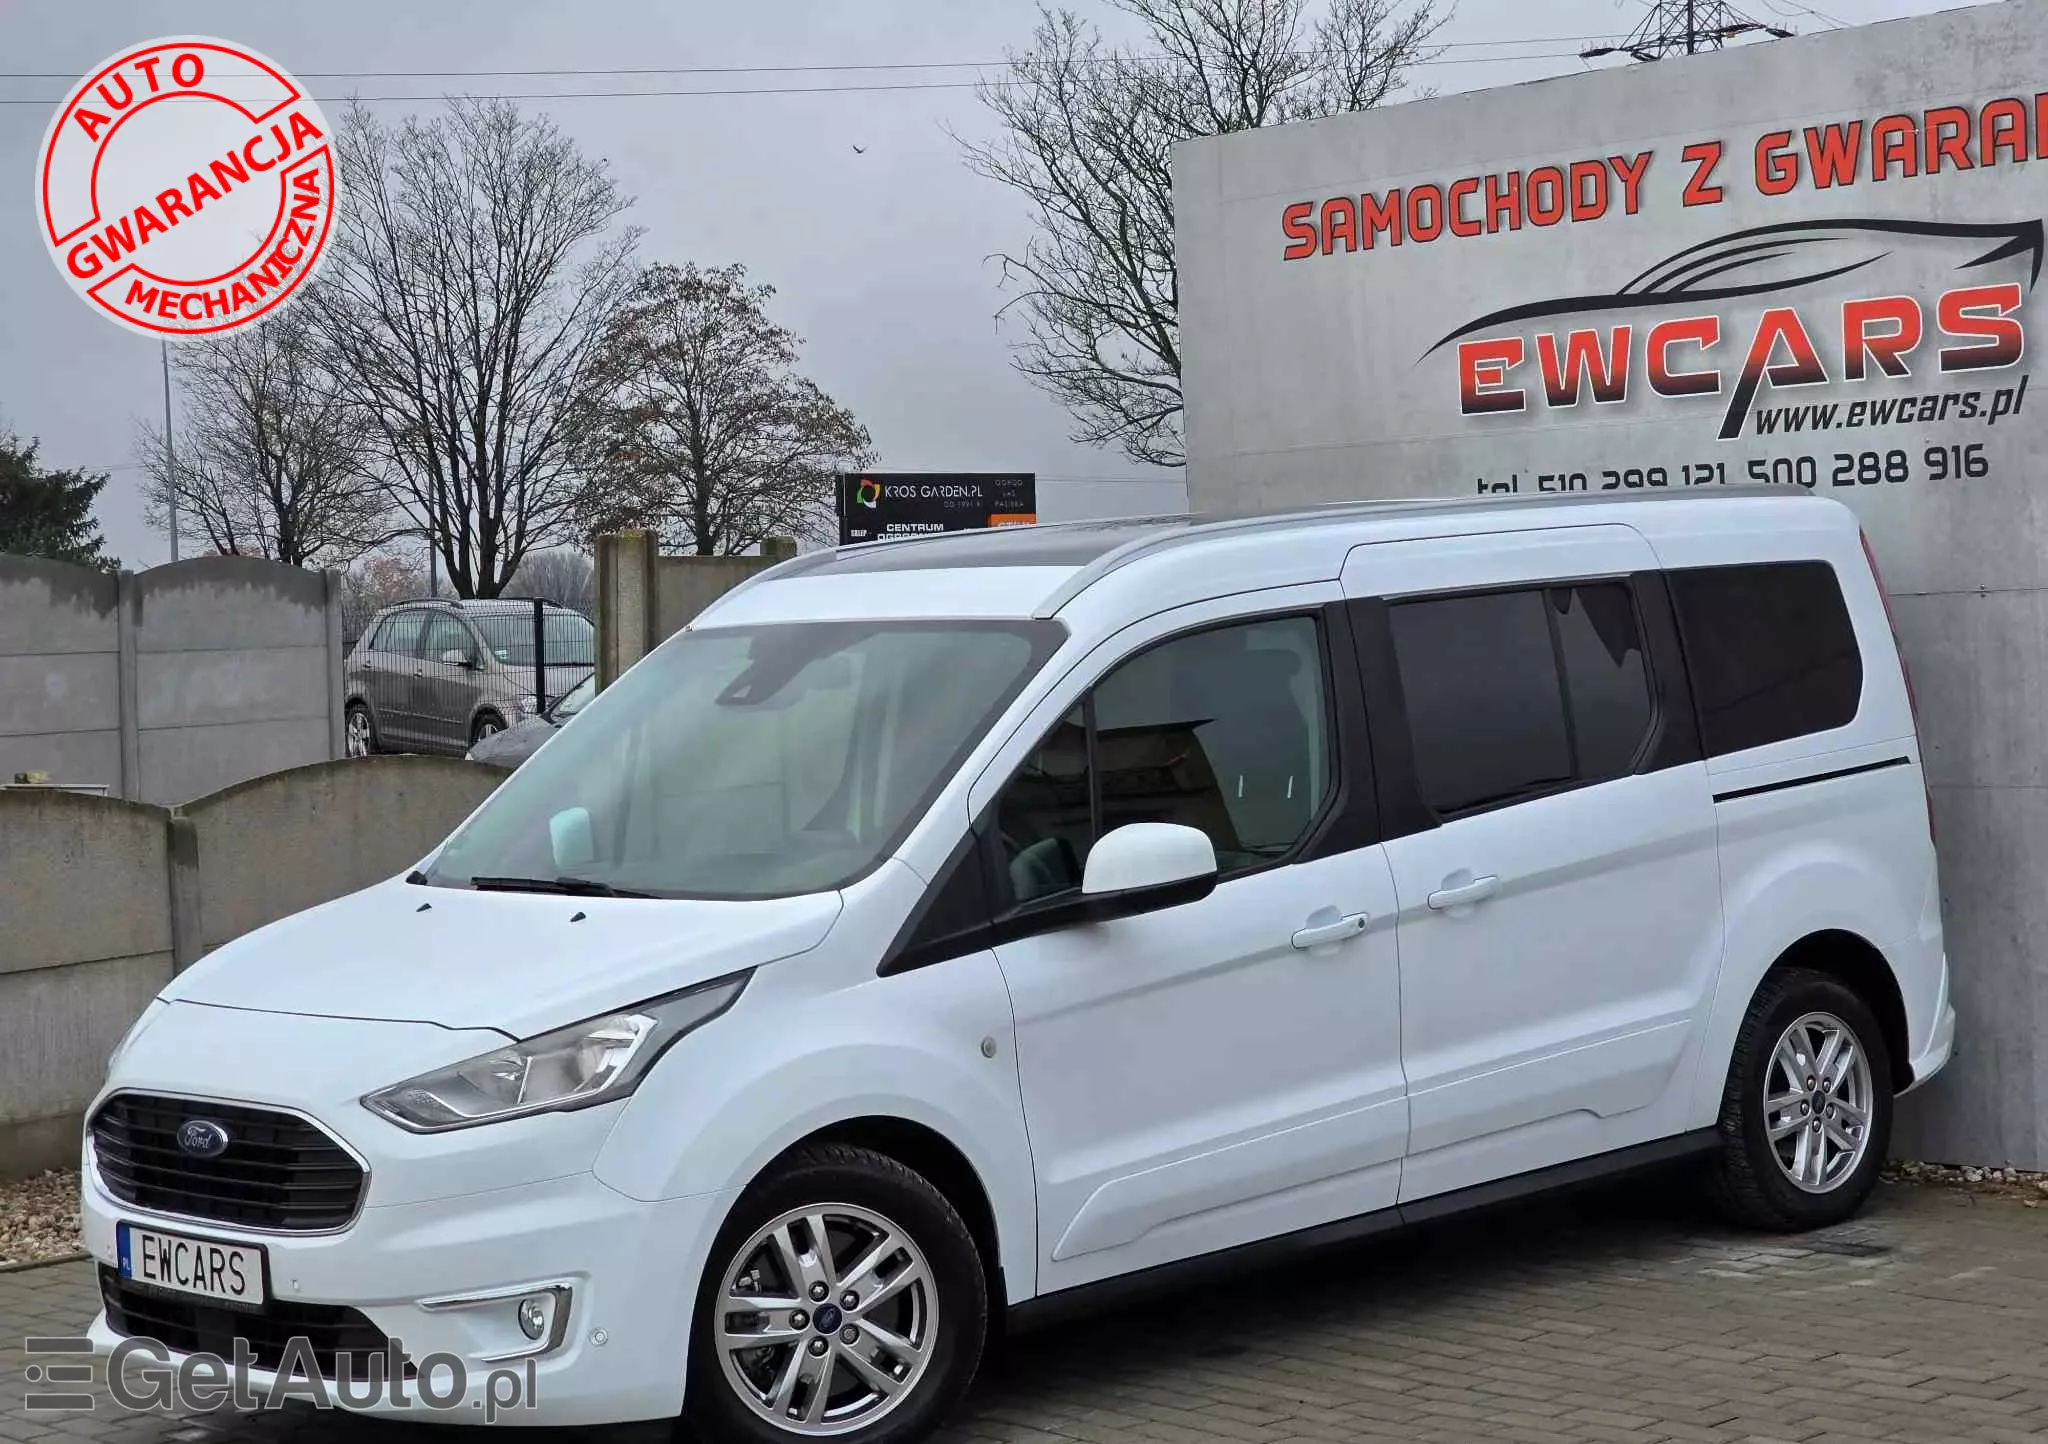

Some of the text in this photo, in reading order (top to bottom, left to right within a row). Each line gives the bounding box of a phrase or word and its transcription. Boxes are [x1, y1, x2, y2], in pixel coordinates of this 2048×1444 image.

[1282, 150, 1653, 261] SAMOCHODY
[1682, 140, 1723, 208] Z
[1457, 283, 2024, 440] EWCARS
[1756, 375, 2029, 435] www.ewcars.pl
[884, 485, 983, 498] KROS GARDEN.PL
[1747, 455, 1817, 489] 500
[1832, 449, 1909, 487] 288
[1924, 443, 1989, 481] 916
[886, 523, 944, 532] CENTRUM
[184, 1126, 212, 1150] Ford
[142, 1234, 246, 1296] EWCARS
